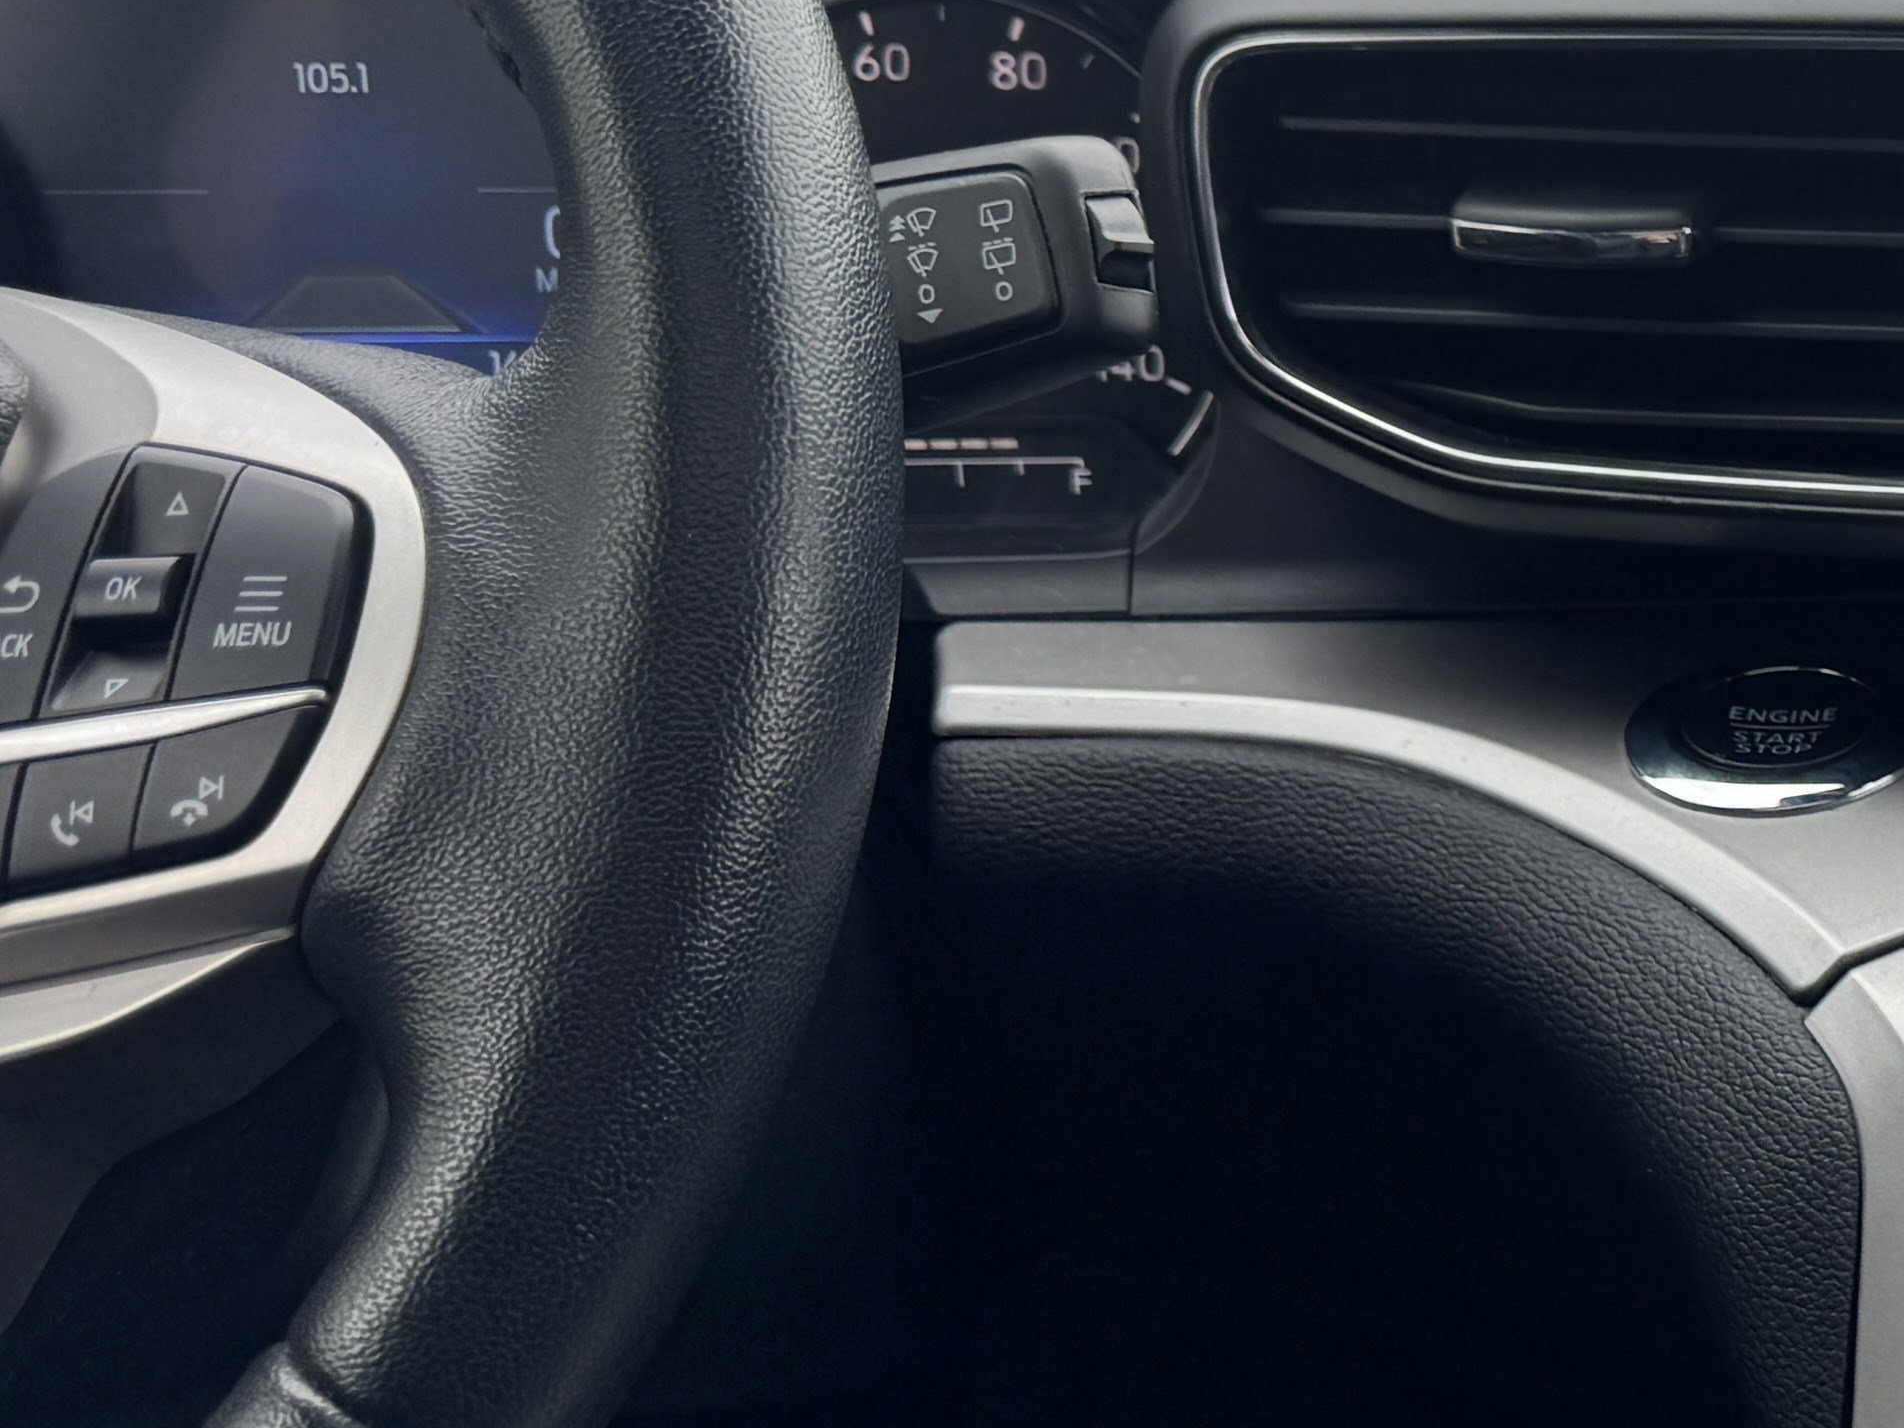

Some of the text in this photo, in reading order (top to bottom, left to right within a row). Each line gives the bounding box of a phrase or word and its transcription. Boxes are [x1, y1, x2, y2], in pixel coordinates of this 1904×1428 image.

[854, 44, 910, 82] 60
[988, 50, 1047, 91] 80
[293, 62, 369, 94] 105.1
[104, 576, 141, 601] OK
[213, 621, 292, 648] MENU
[1728, 705, 1838, 723] ENGINE
[1732, 730, 1823, 744] START
[1735, 743, 1813, 755] STOP
